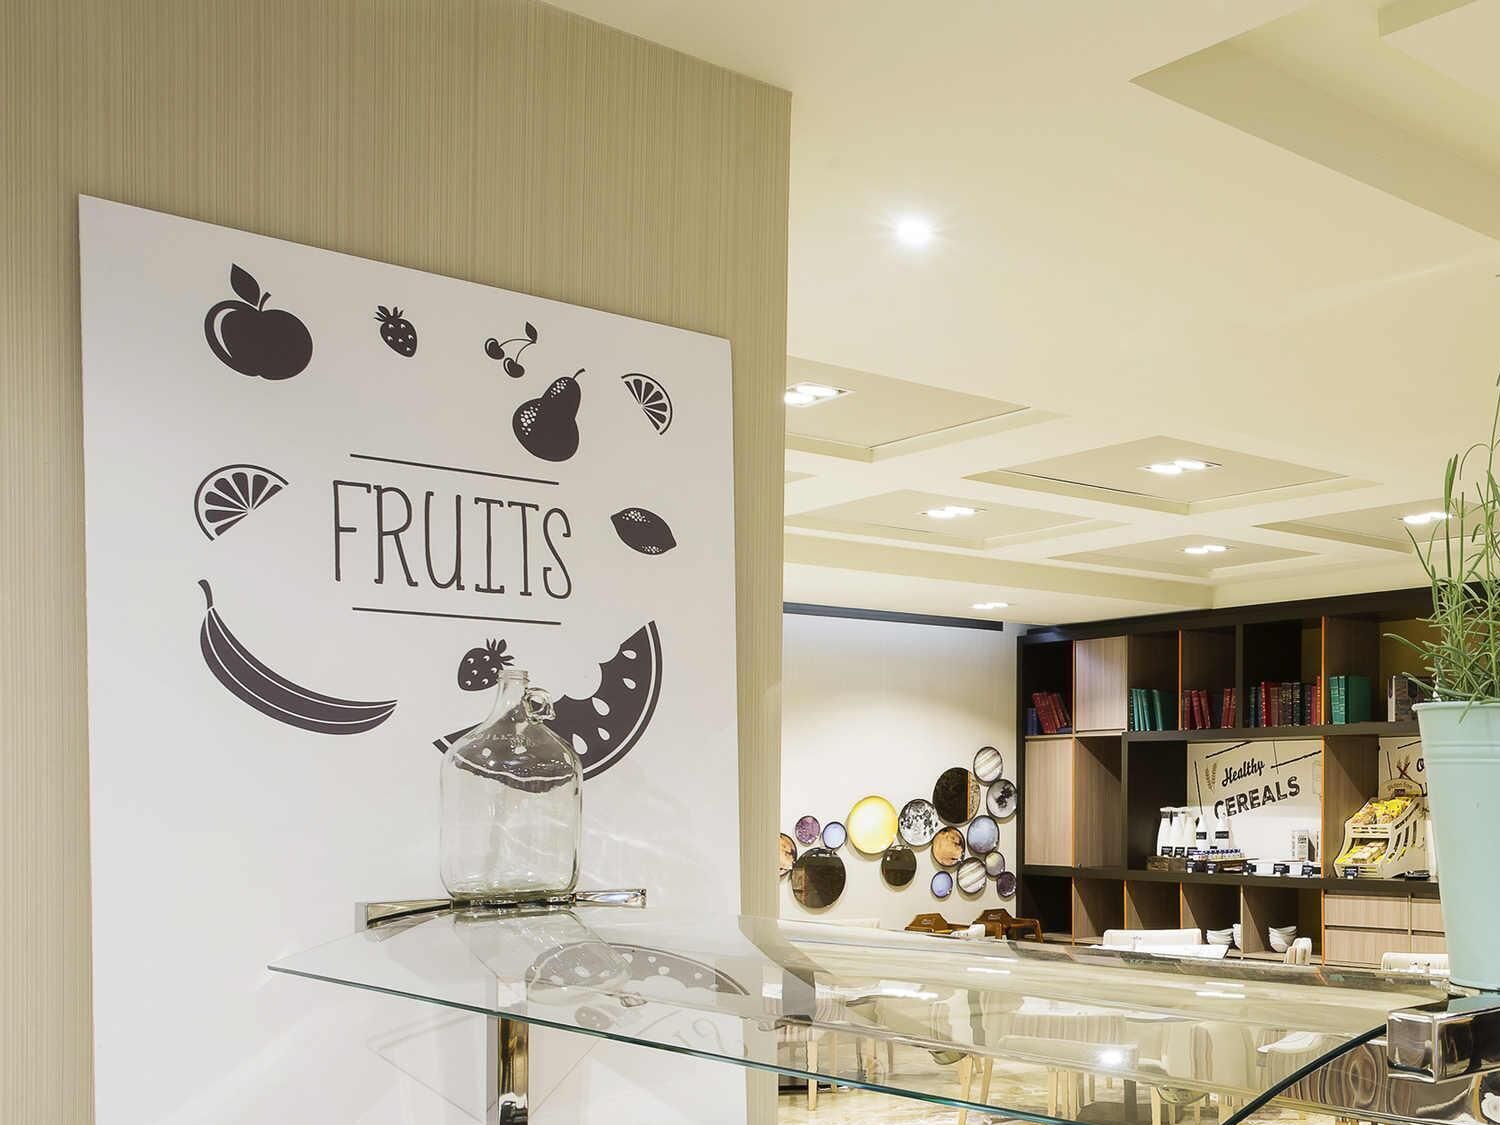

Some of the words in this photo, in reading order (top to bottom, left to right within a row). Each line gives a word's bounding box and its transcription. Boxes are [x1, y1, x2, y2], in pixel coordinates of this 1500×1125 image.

[332, 479, 573, 600] FRUITS
[1221, 757, 1266, 787] Healthy
[1213, 775, 1302, 820] CEREALS
